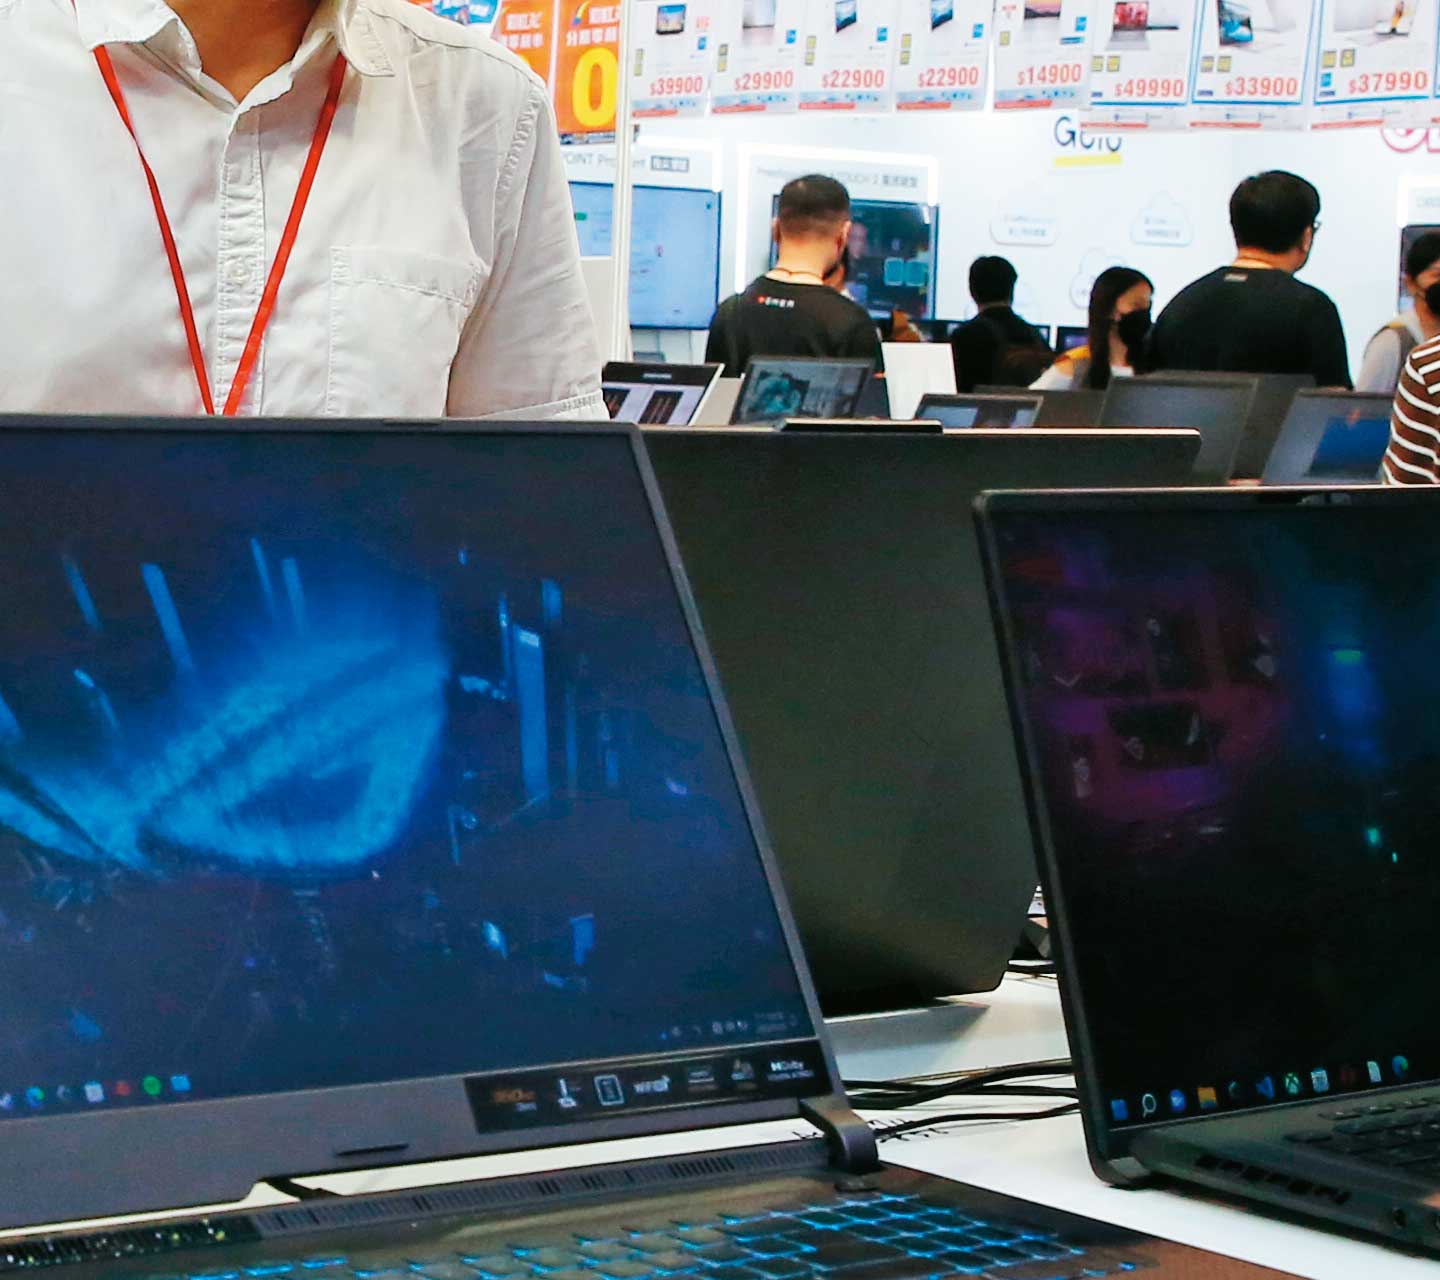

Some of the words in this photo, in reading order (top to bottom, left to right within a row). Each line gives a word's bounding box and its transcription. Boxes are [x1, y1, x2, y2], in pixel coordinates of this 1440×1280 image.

[734, 70, 794, 91] $29900
[821, 68, 885, 90] $22900
[918, 67, 980, 88] $22900
[1017, 64, 1082, 86] $14900
[1348, 72, 1428, 94] $37990
[649, 75, 704, 97] $39900
[1115, 79, 1184, 99] $49990
[1226, 77, 1298, 98] $33900
